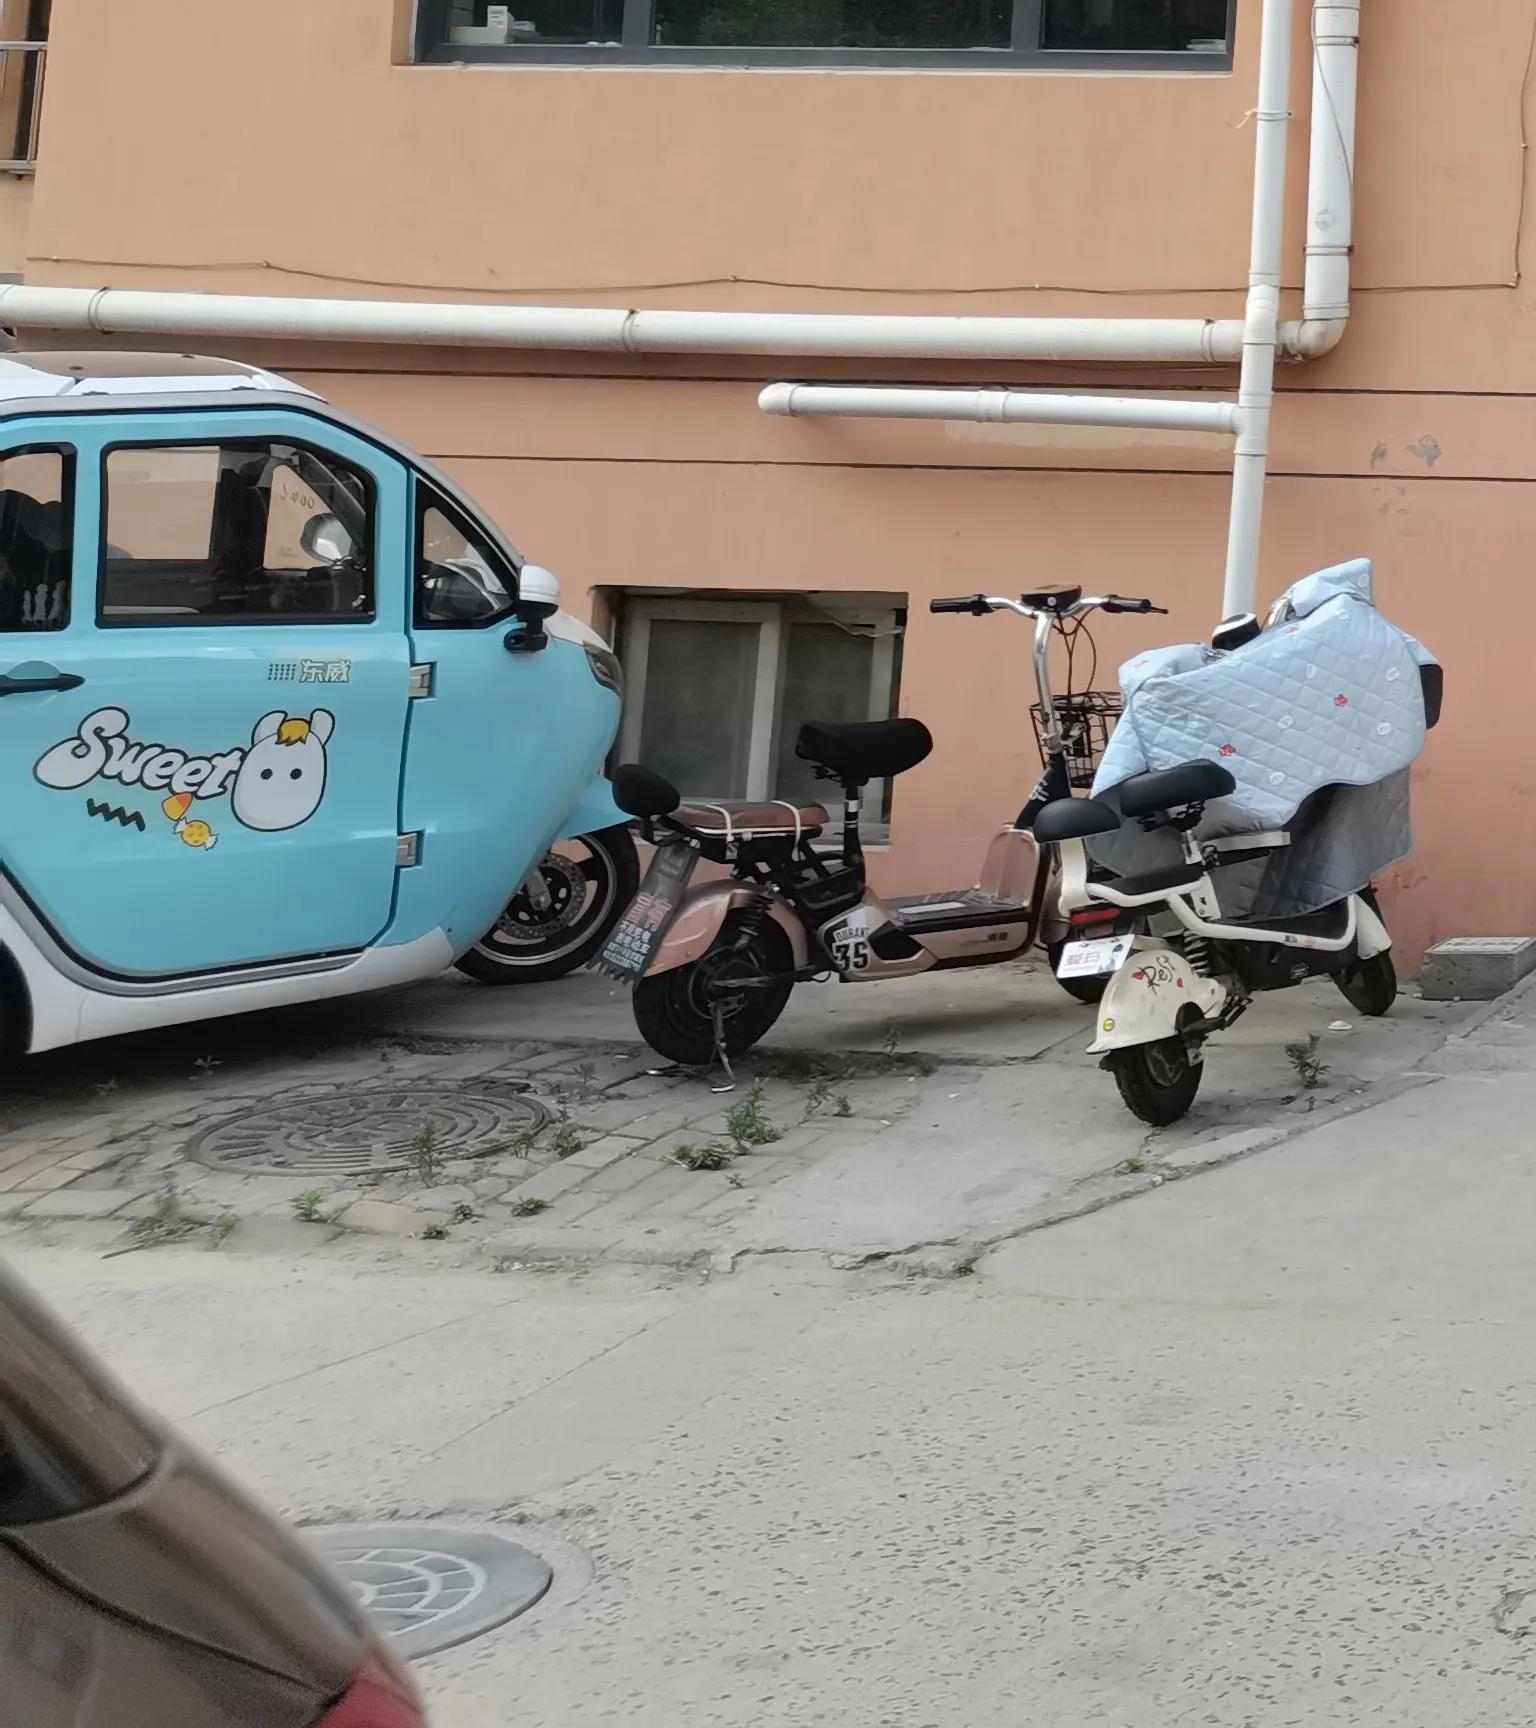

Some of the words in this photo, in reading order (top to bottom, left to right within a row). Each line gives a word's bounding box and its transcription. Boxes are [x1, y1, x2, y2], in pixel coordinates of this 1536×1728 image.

[299, 658, 352, 684] 东威
[32, 705, 247, 802] Sweet
[832, 941, 871, 973] 35
